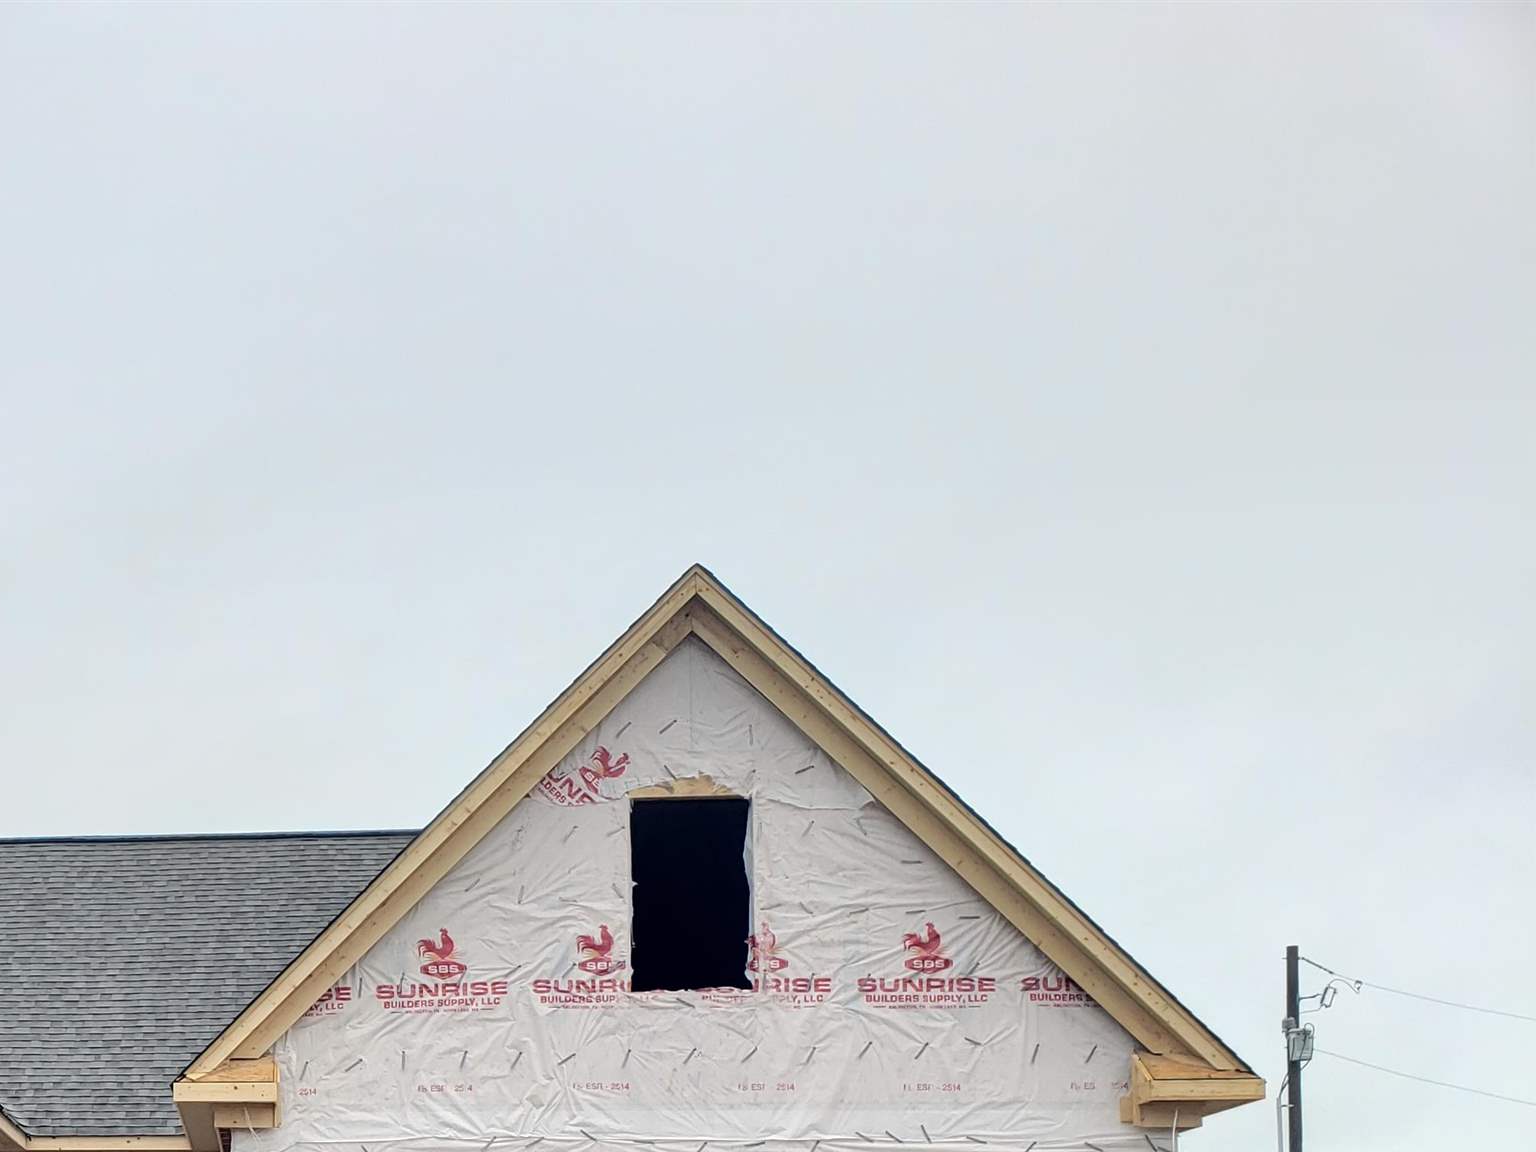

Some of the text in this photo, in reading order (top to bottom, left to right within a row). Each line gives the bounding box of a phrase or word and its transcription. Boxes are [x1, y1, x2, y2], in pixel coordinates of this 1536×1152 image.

[428, 963, 459, 975] SBS
[913, 958, 944, 969] SBS
[375, 980, 509, 1000] SUNRISE
[857, 977, 996, 993] SUNRISE
[539, 994, 593, 1004] BUILDERS
[804, 994, 824, 1003] LLC
[865, 994, 988, 1006] BUILDERS SUPPLY, LLC
[1030, 993, 1083, 1002] BUILDERS
[325, 1002, 344, 1011] LLC
[384, 999, 435, 1010] BUILDERS
[437, 997, 478, 1009] SUPPLY,
[480, 997, 501, 1006] LLC
